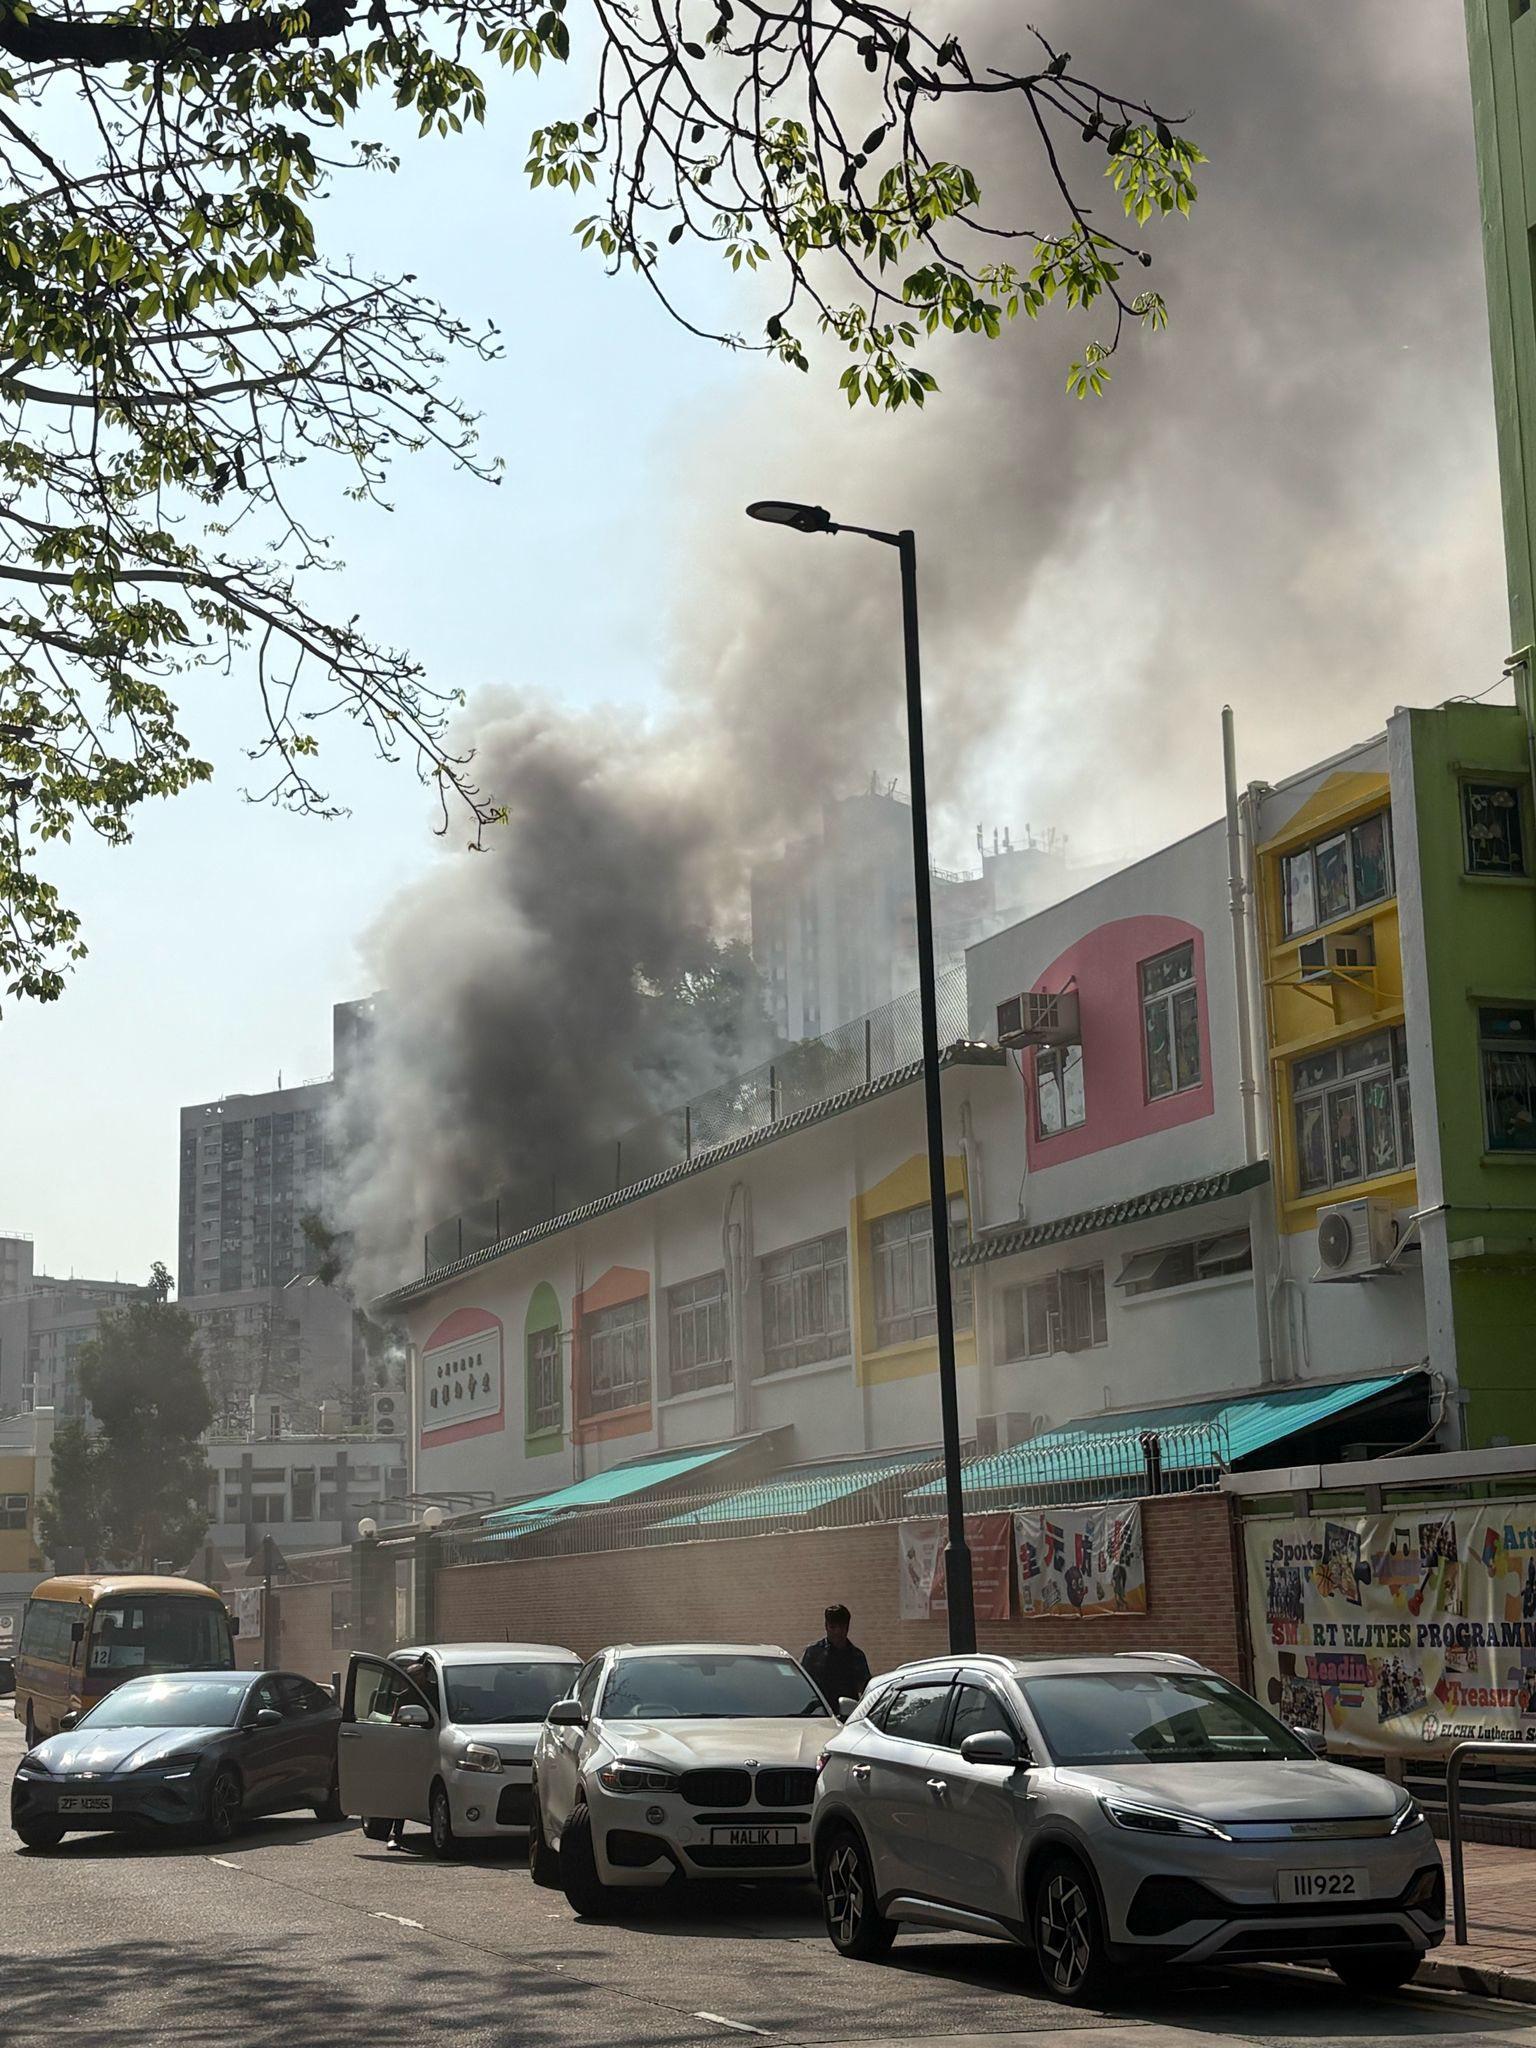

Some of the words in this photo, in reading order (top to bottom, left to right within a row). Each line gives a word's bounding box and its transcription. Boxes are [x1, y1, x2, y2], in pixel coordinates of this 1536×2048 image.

[1503, 1525, 1536, 1549] Art
[1272, 1539, 1323, 1566] Sports
[1342, 1623, 1411, 1648] ELITES
[1305, 1655, 1377, 1687] Reading
[1447, 1681, 1531, 1710] Treasure
[1440, 1724, 1476, 1739] ELCHK
[1477, 1726, 1523, 1741] Lutheran
[730, 1830, 770, 1844] MALIK
